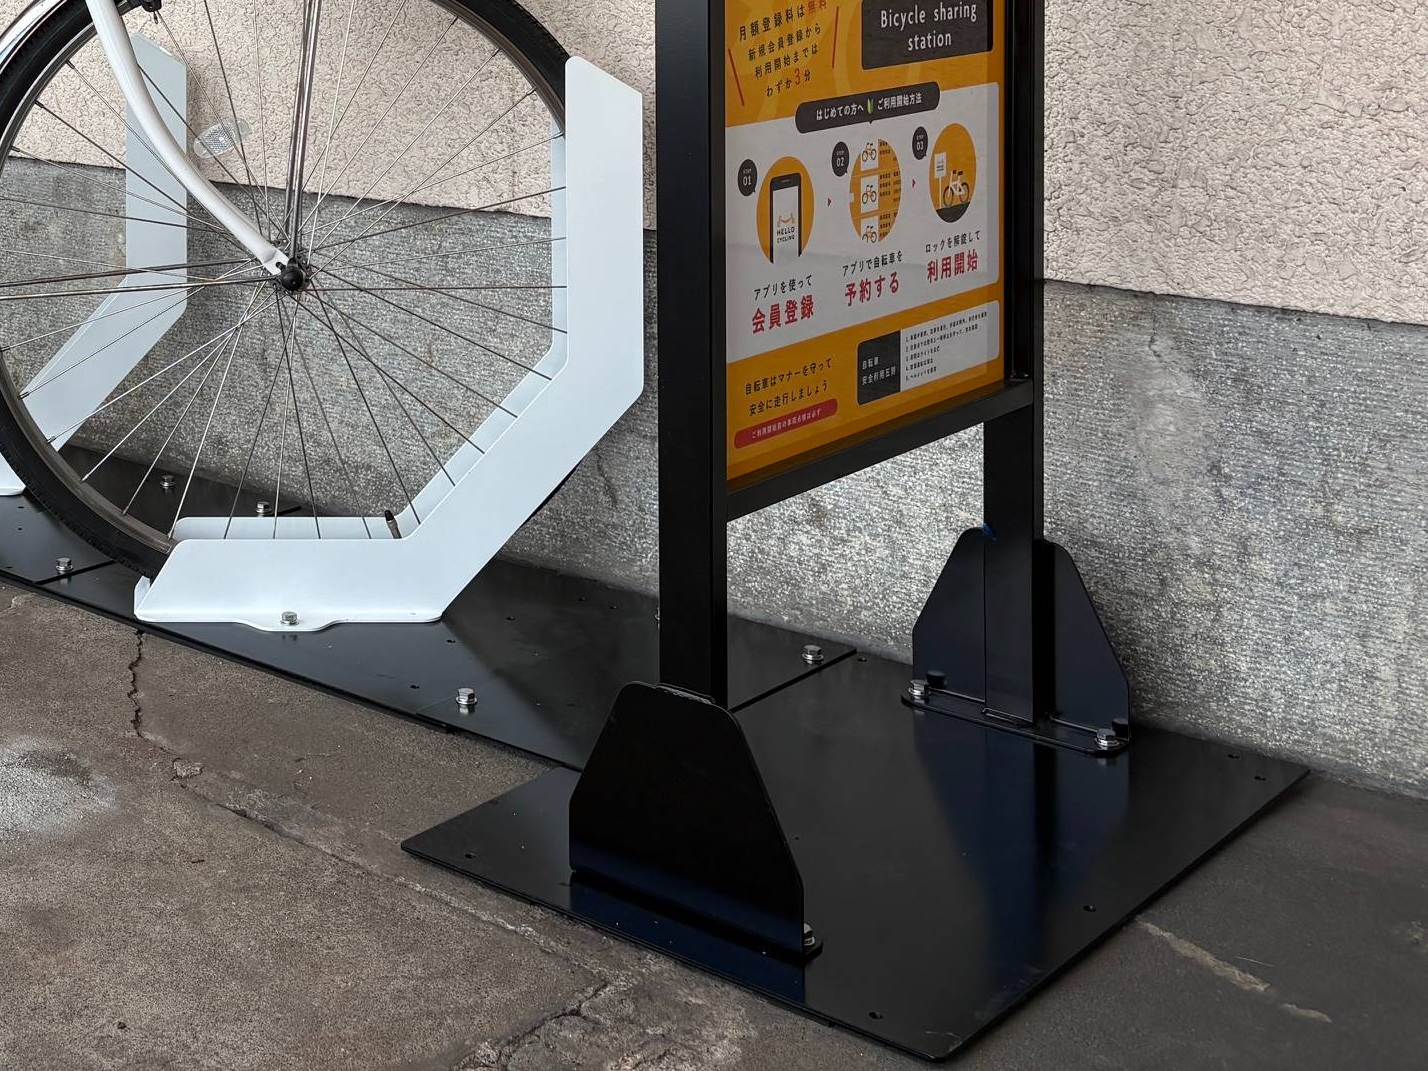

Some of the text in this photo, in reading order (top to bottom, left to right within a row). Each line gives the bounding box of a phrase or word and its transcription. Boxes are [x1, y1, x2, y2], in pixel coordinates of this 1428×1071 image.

[880, 1, 978, 30] Bicycle sharing
[907, 31, 953, 51] station
[755, 44, 818, 79] 利用開始までは
[766, 68, 812, 97] わずか3分
[816, 92, 923, 121] はじめての方へ ご利用開始方法
[916, 141, 924, 151] 03
[836, 158, 845, 167] 02
[742, 175, 752, 186] 01
[776, 226, 795, 236] HELLO
[843, 251, 903, 277] アプリで自転車を
[927, 249, 978, 283] 利用開始
[753, 275, 812, 300] アプリを使って
[844, 272, 900, 307] 予約する
[752, 295, 815, 334] 会員登録
[745, 357, 832, 395] 自転車はマナーを守って
[749, 380, 829, 417] 安全に走行しましょう
